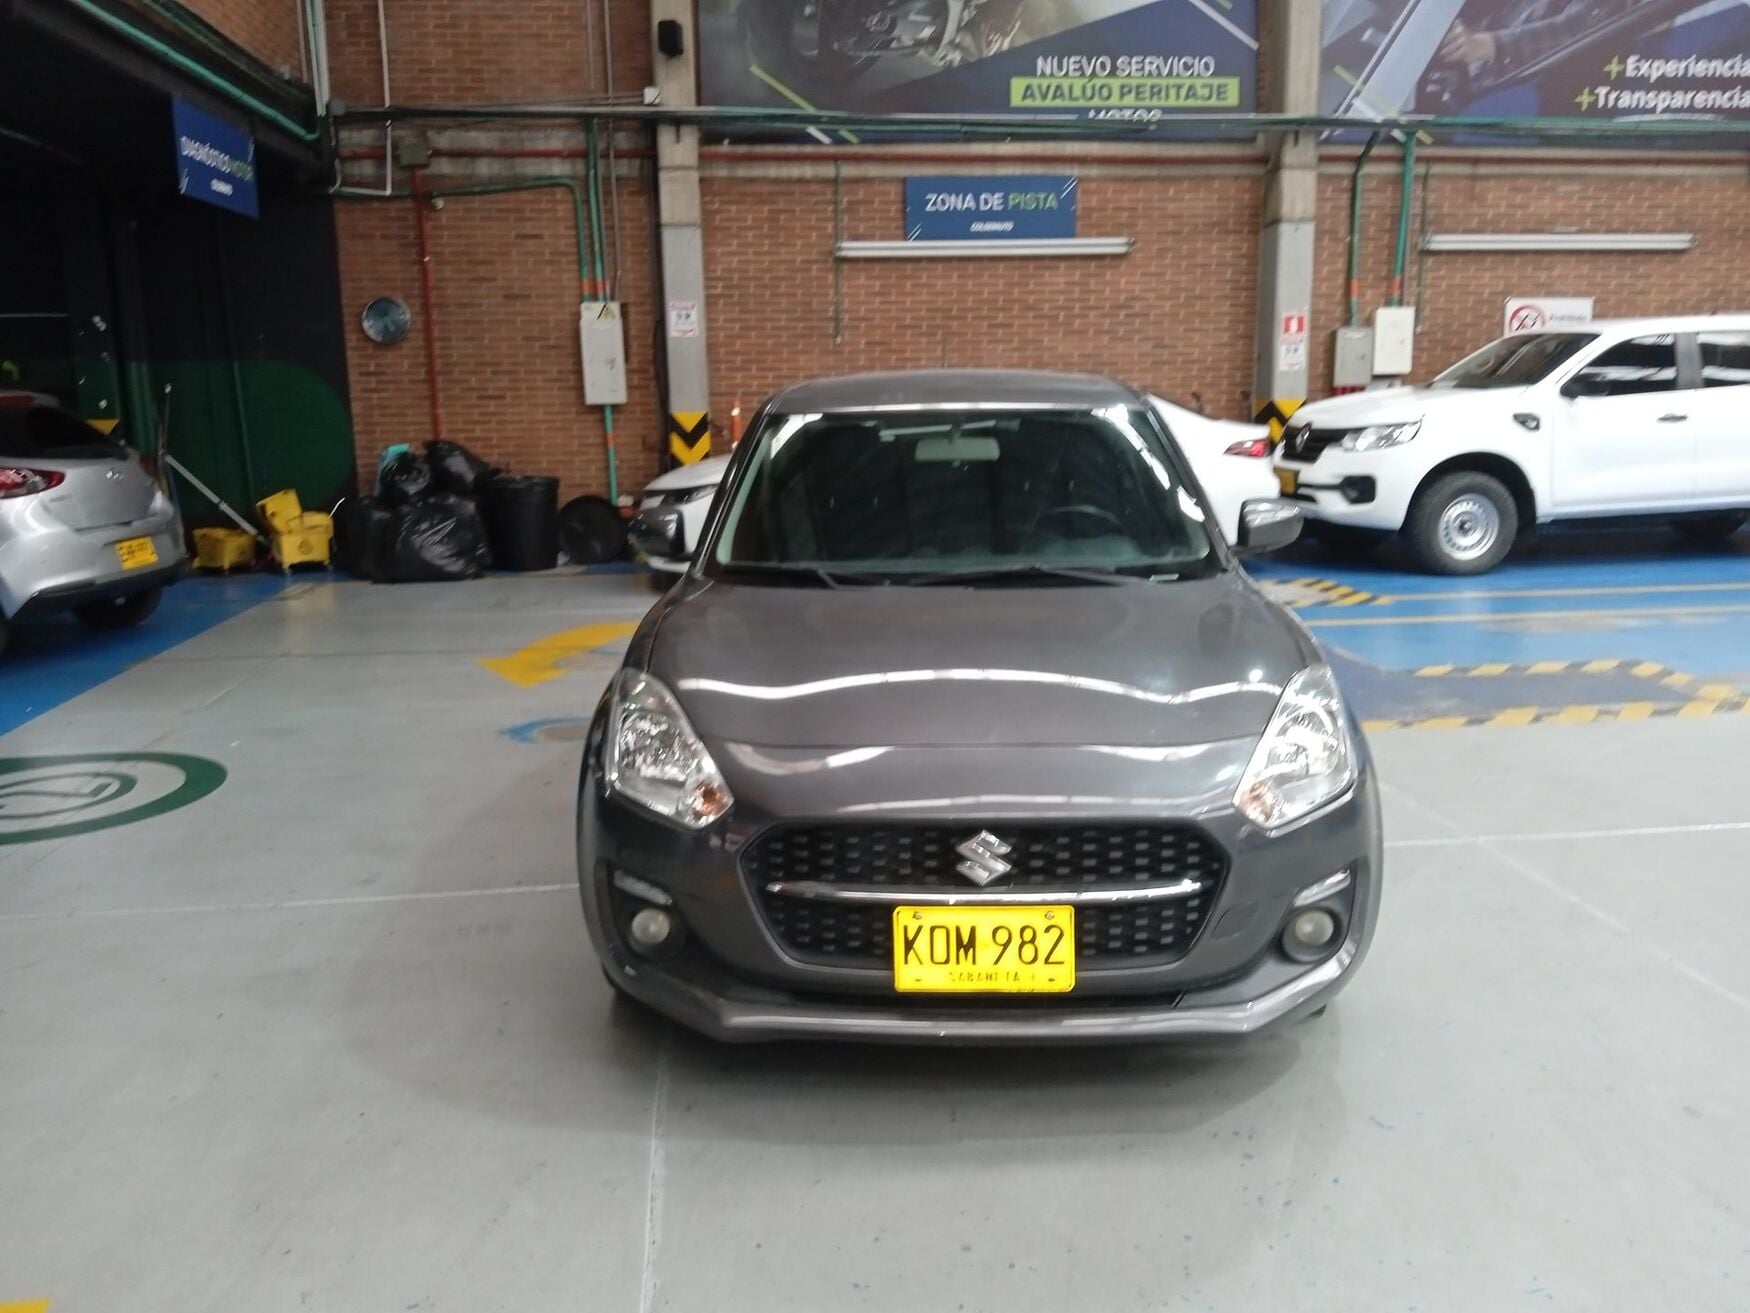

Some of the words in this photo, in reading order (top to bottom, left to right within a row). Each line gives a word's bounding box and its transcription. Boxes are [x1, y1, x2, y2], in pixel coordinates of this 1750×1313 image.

[1036, 55, 1111, 77] NUEVO
[1116, 55, 1215, 77] SERVICIO
[1021, 76, 1112, 101] AVALÚO
[1119, 82, 1229, 101] PERITAJE
[925, 192, 976, 212] ZONA
[979, 192, 1004, 211] DE
[1008, 191, 1059, 211] PISTA
[903, 925, 977, 966] KOM
[991, 924, 1065, 966] 982
